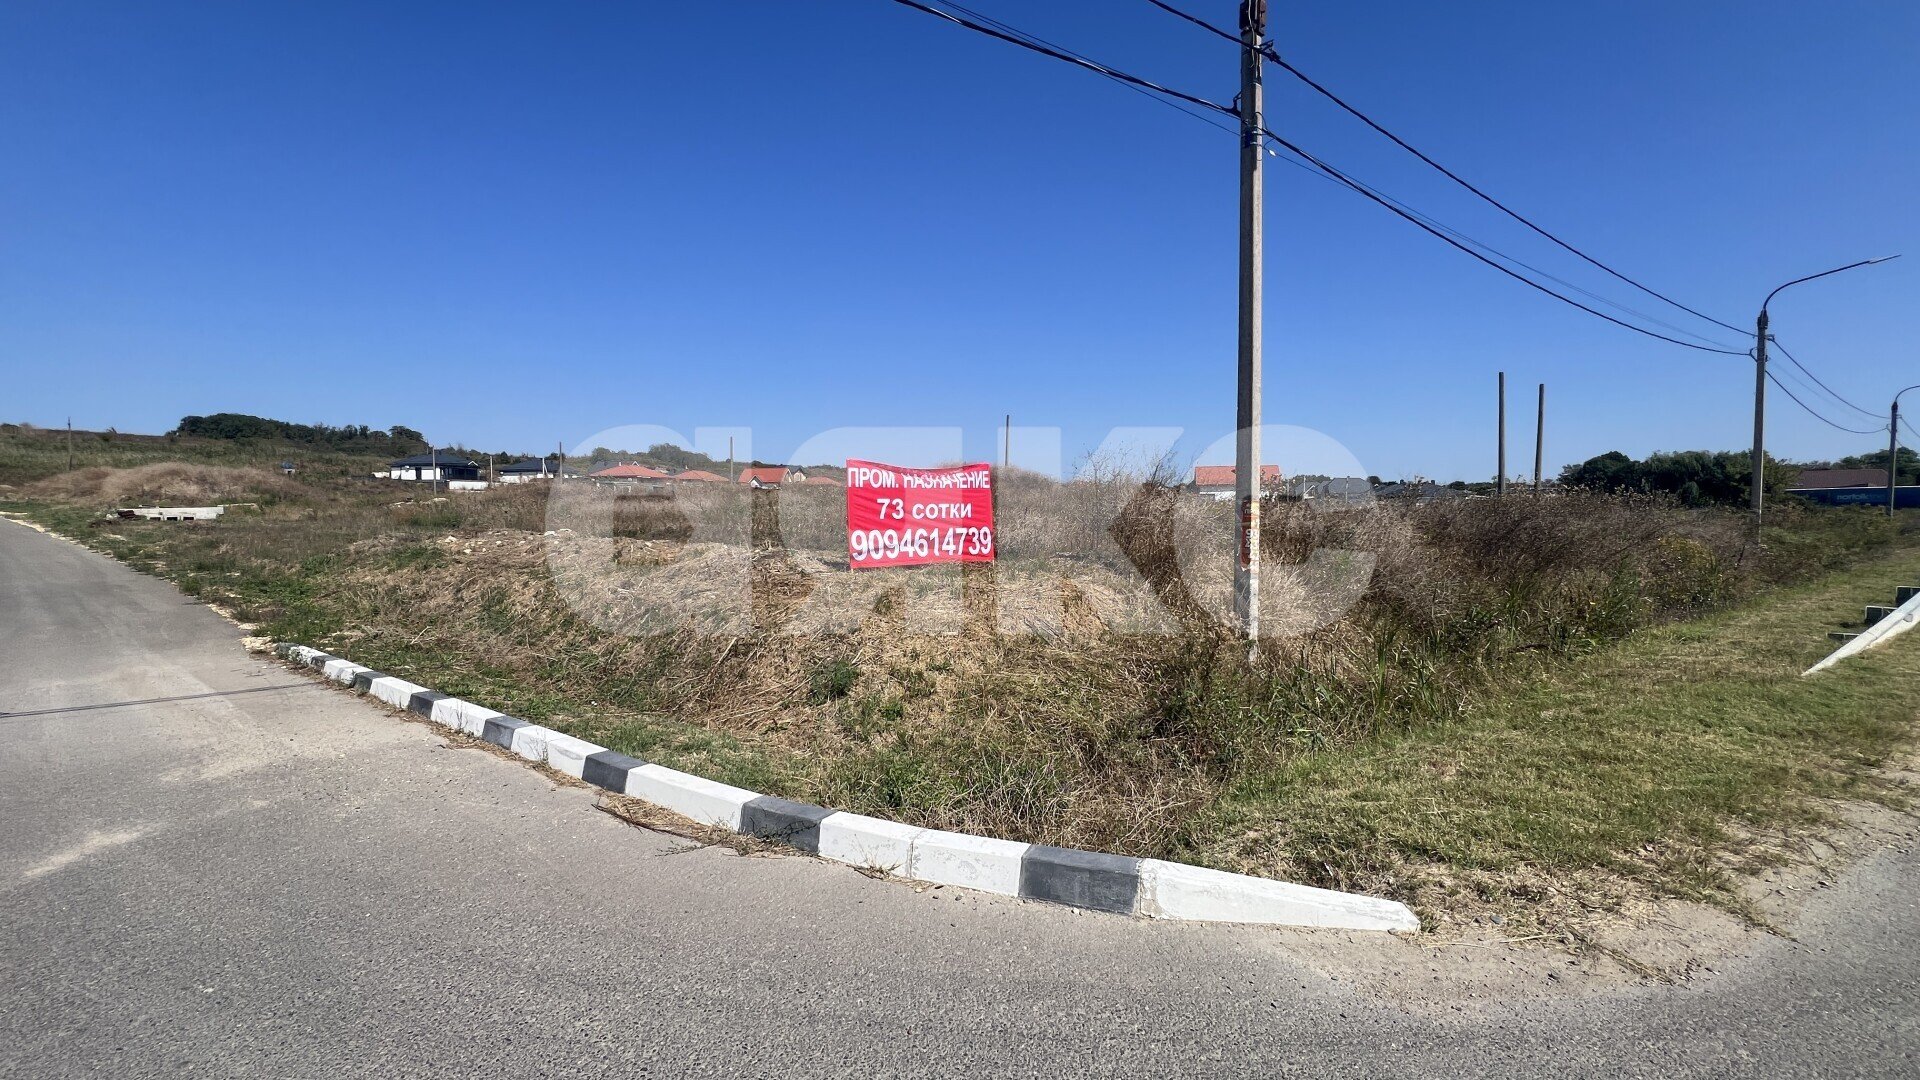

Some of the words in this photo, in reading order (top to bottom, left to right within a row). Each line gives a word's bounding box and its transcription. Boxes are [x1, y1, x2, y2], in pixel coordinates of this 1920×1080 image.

[848, 467, 898, 488] ПРОМ.
[901, 471, 990, 489] НАЗНАЧЕНИЕ
[877, 498, 904, 519] 73
[851, 526, 992, 561] 9094614739
